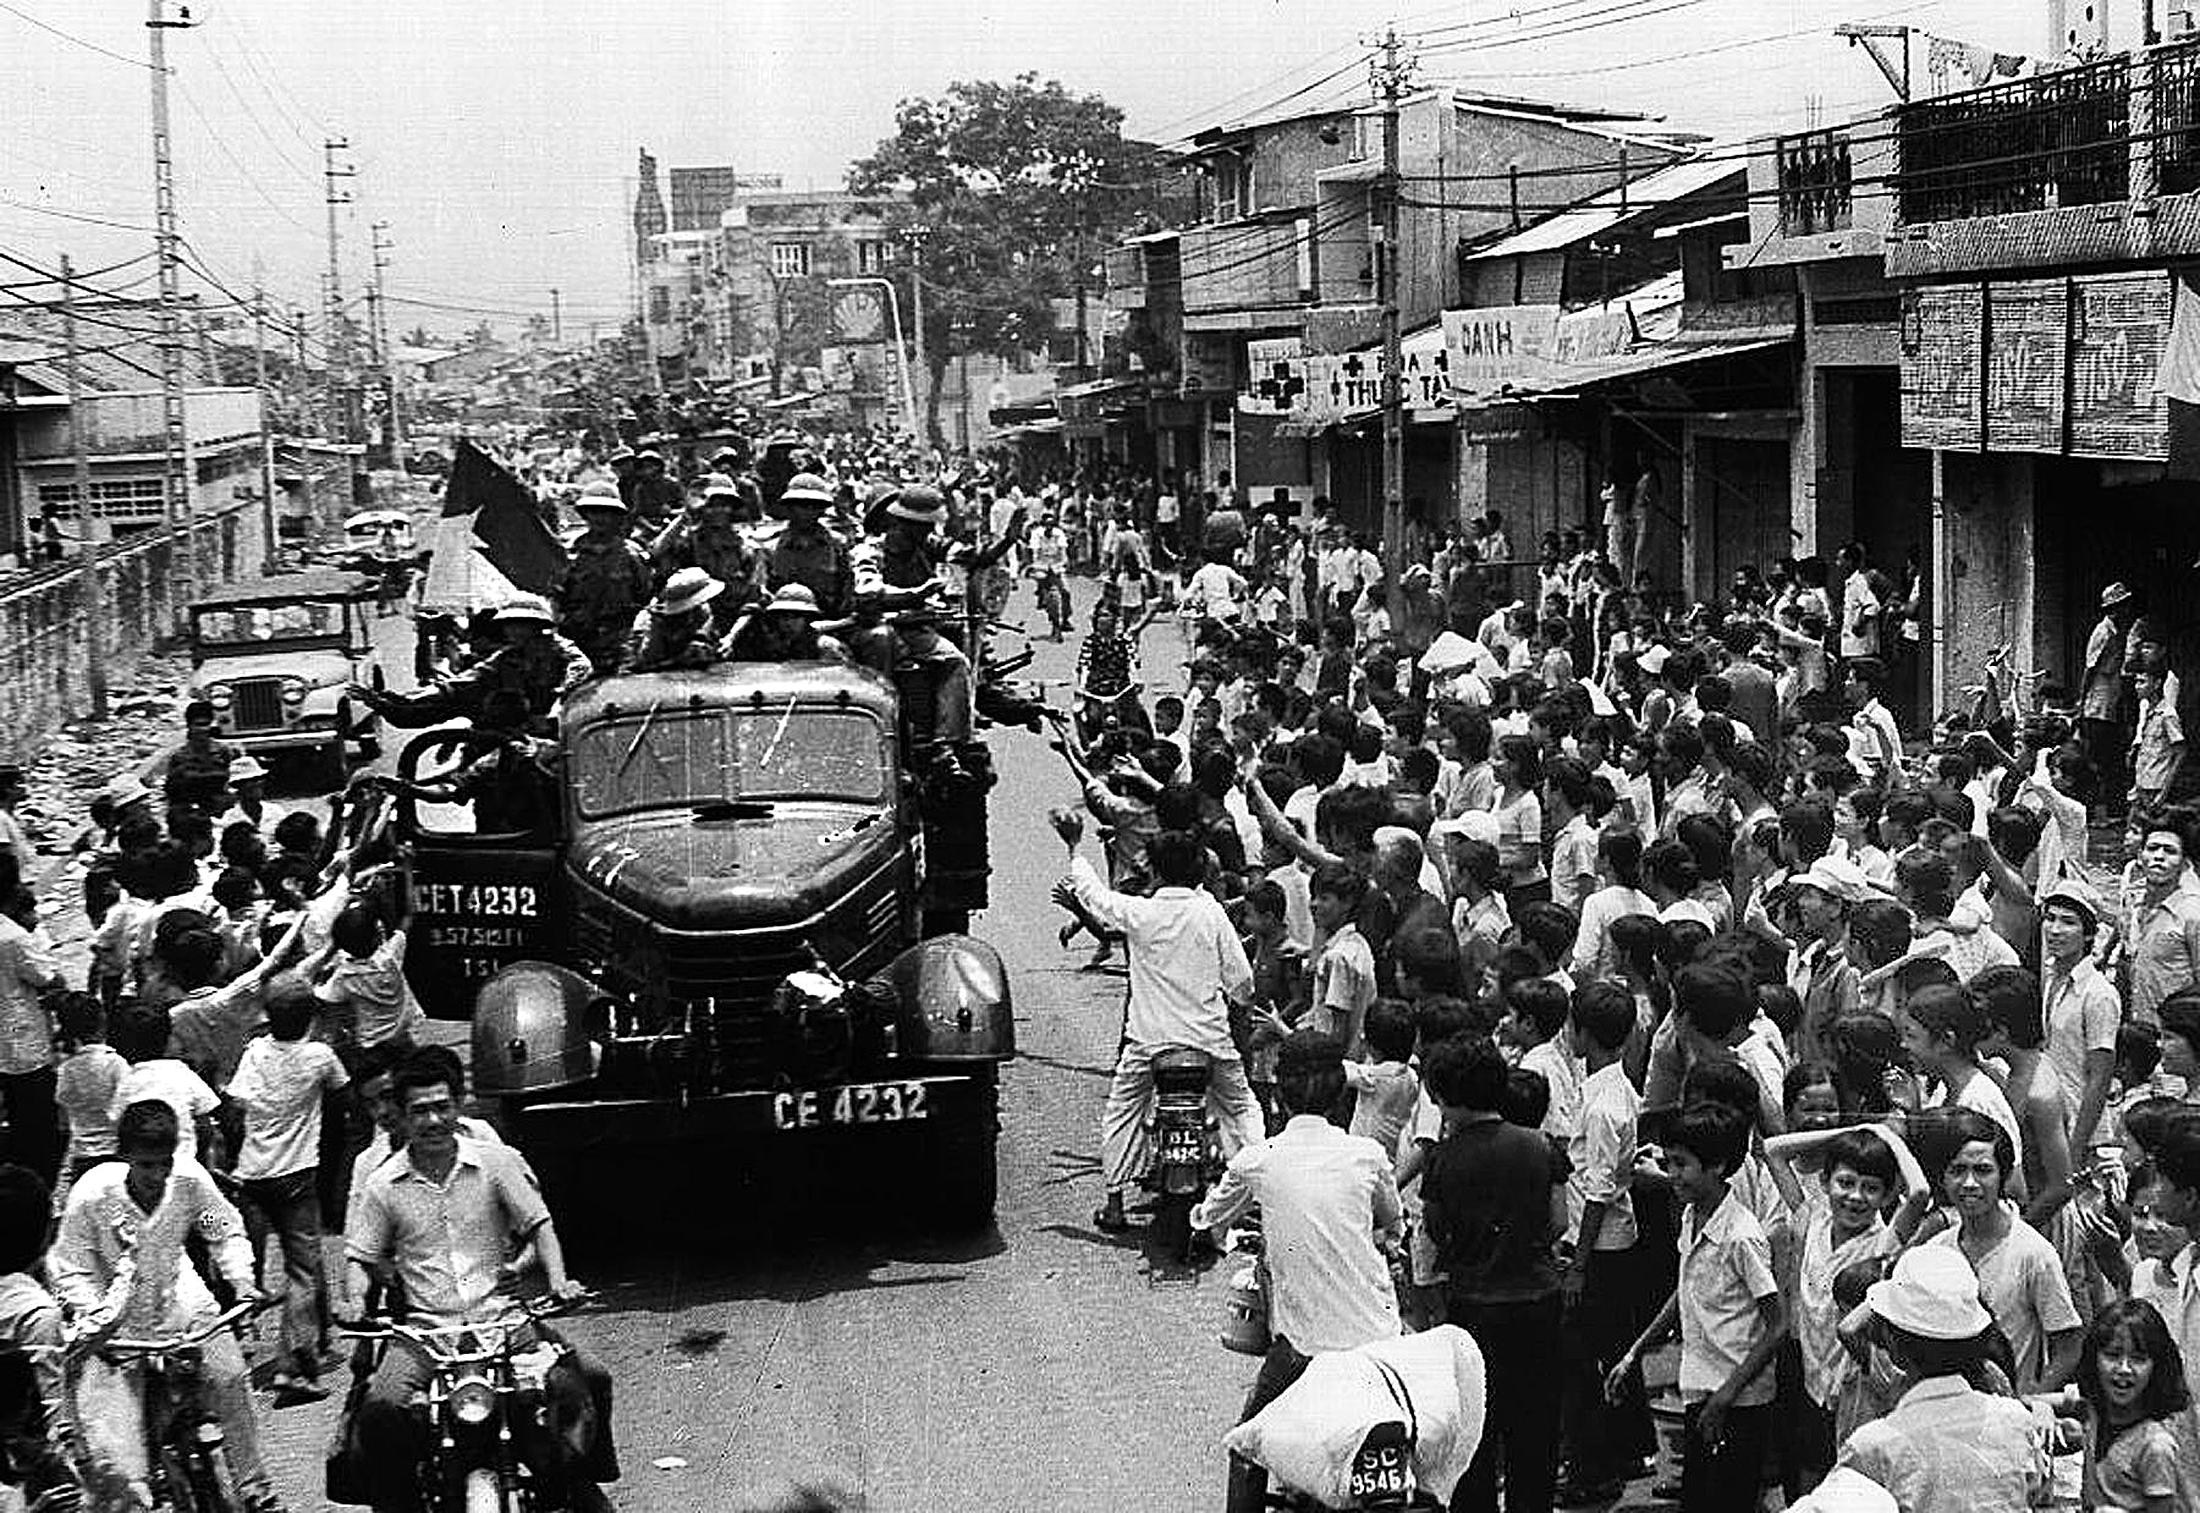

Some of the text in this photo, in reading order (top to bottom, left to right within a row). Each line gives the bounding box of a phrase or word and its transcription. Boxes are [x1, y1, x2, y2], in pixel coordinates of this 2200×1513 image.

[1345, 377, 1411, 406] THUC
[774, 1082, 928, 1130] CE 4232
[1363, 1447, 1398, 1469] SC
